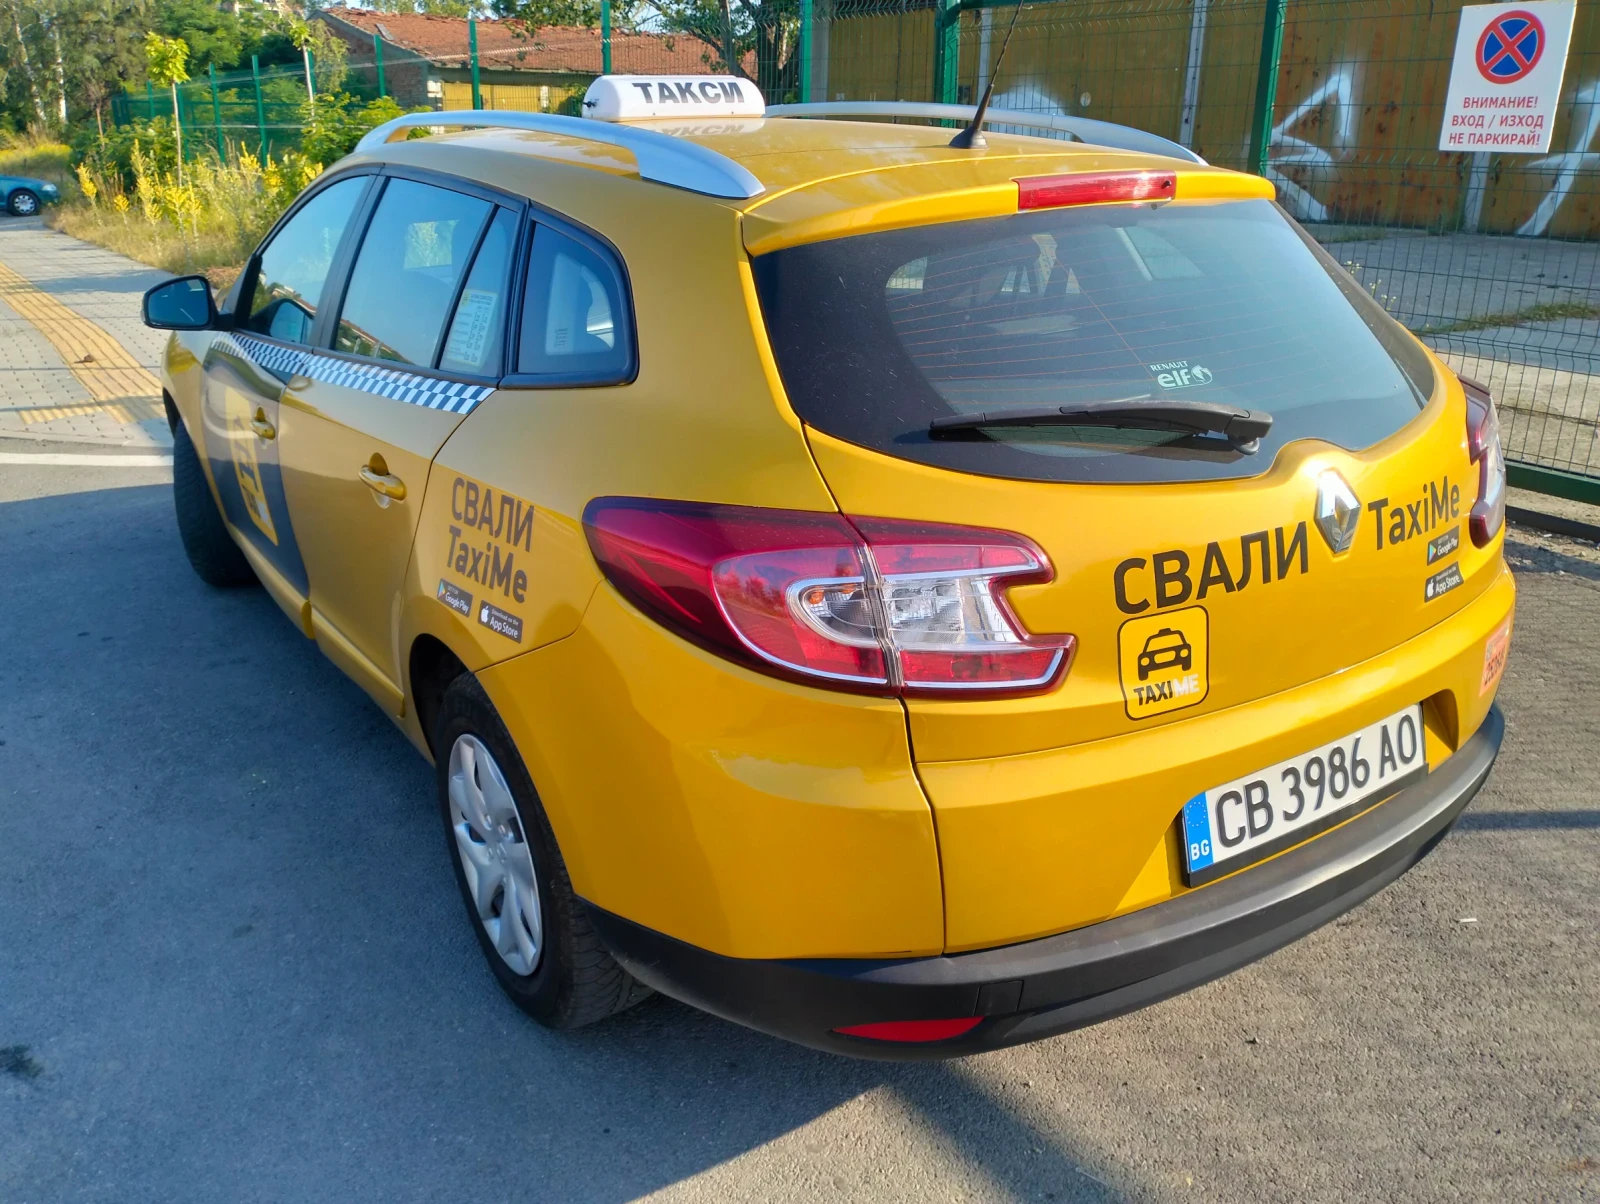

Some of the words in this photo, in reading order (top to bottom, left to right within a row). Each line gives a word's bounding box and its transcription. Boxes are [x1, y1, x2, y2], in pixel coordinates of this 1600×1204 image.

[632, 82, 744, 104] ТАКСИ
[1463, 96, 1538, 109] ВНИМАНИЕ!
[1452, 115, 1485, 129] ВХОД
[1500, 115, 1544, 129] ИЗХОД
[1449, 133, 1464, 144] НЕ
[1468, 130, 1540, 146] ПАРКИРАЙ!
[1150, 360, 1189, 372] RENAULT
[1157, 368, 1191, 388] elf
[452, 477, 534, 552] СВАЛИ
[1367, 476, 1460, 551] TaxiMe
[447, 525, 527, 603] TaxiMe
[1114, 521, 1309, 614] СВАЛИ
[1446, 575, 1460, 588] Store
[445, 592, 460, 608] Google
[490, 616, 502, 632] App
[502, 622, 518, 638] Store
[1216, 779, 1274, 848] CB
[1282, 736, 1370, 821] 3986
[1190, 839, 1210, 861] BG
